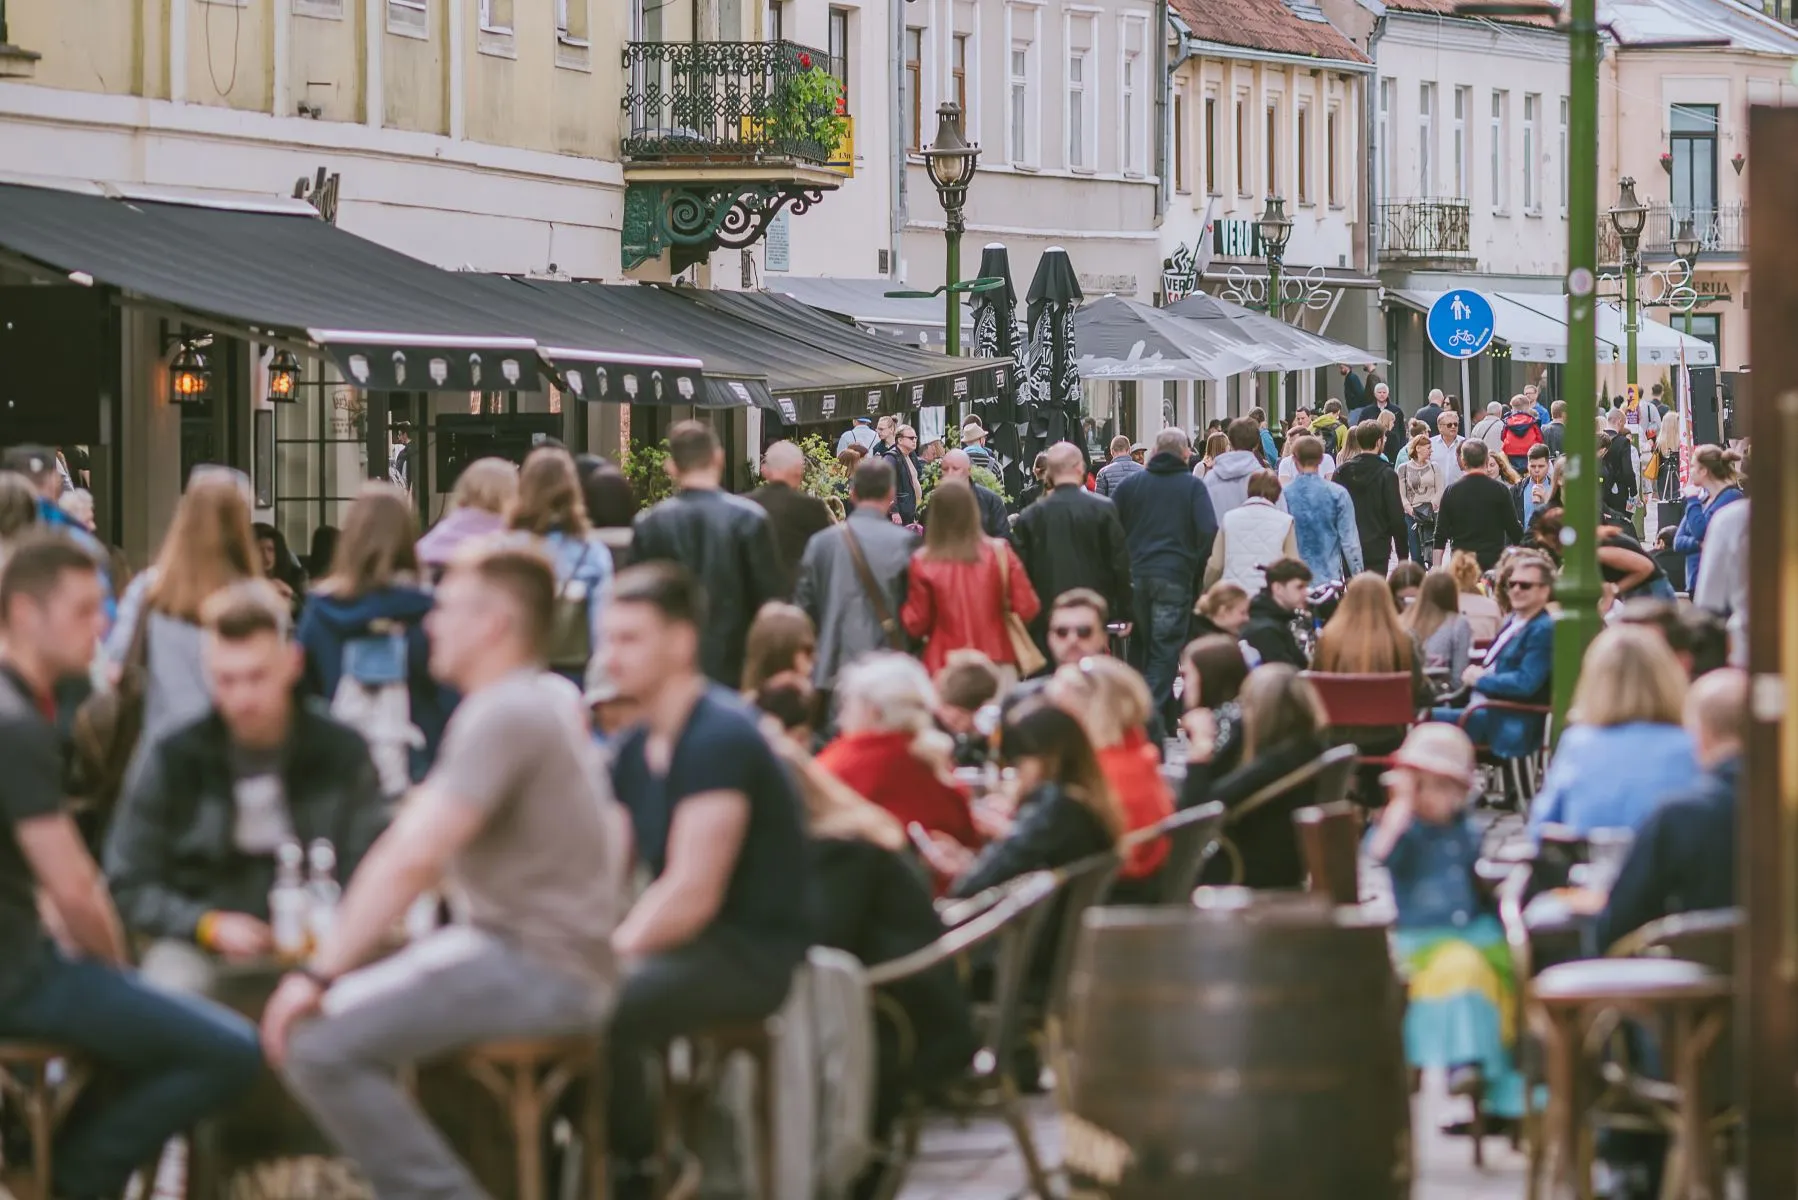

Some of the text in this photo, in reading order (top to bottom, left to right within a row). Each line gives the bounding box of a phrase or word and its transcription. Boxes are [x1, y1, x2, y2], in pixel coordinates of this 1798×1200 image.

[1221, 219, 1252, 256] VERO
[1165, 276, 1194, 291] VERO
[1692, 281, 1730, 293] ERIJA
[1168, 291, 1192, 304] CA
